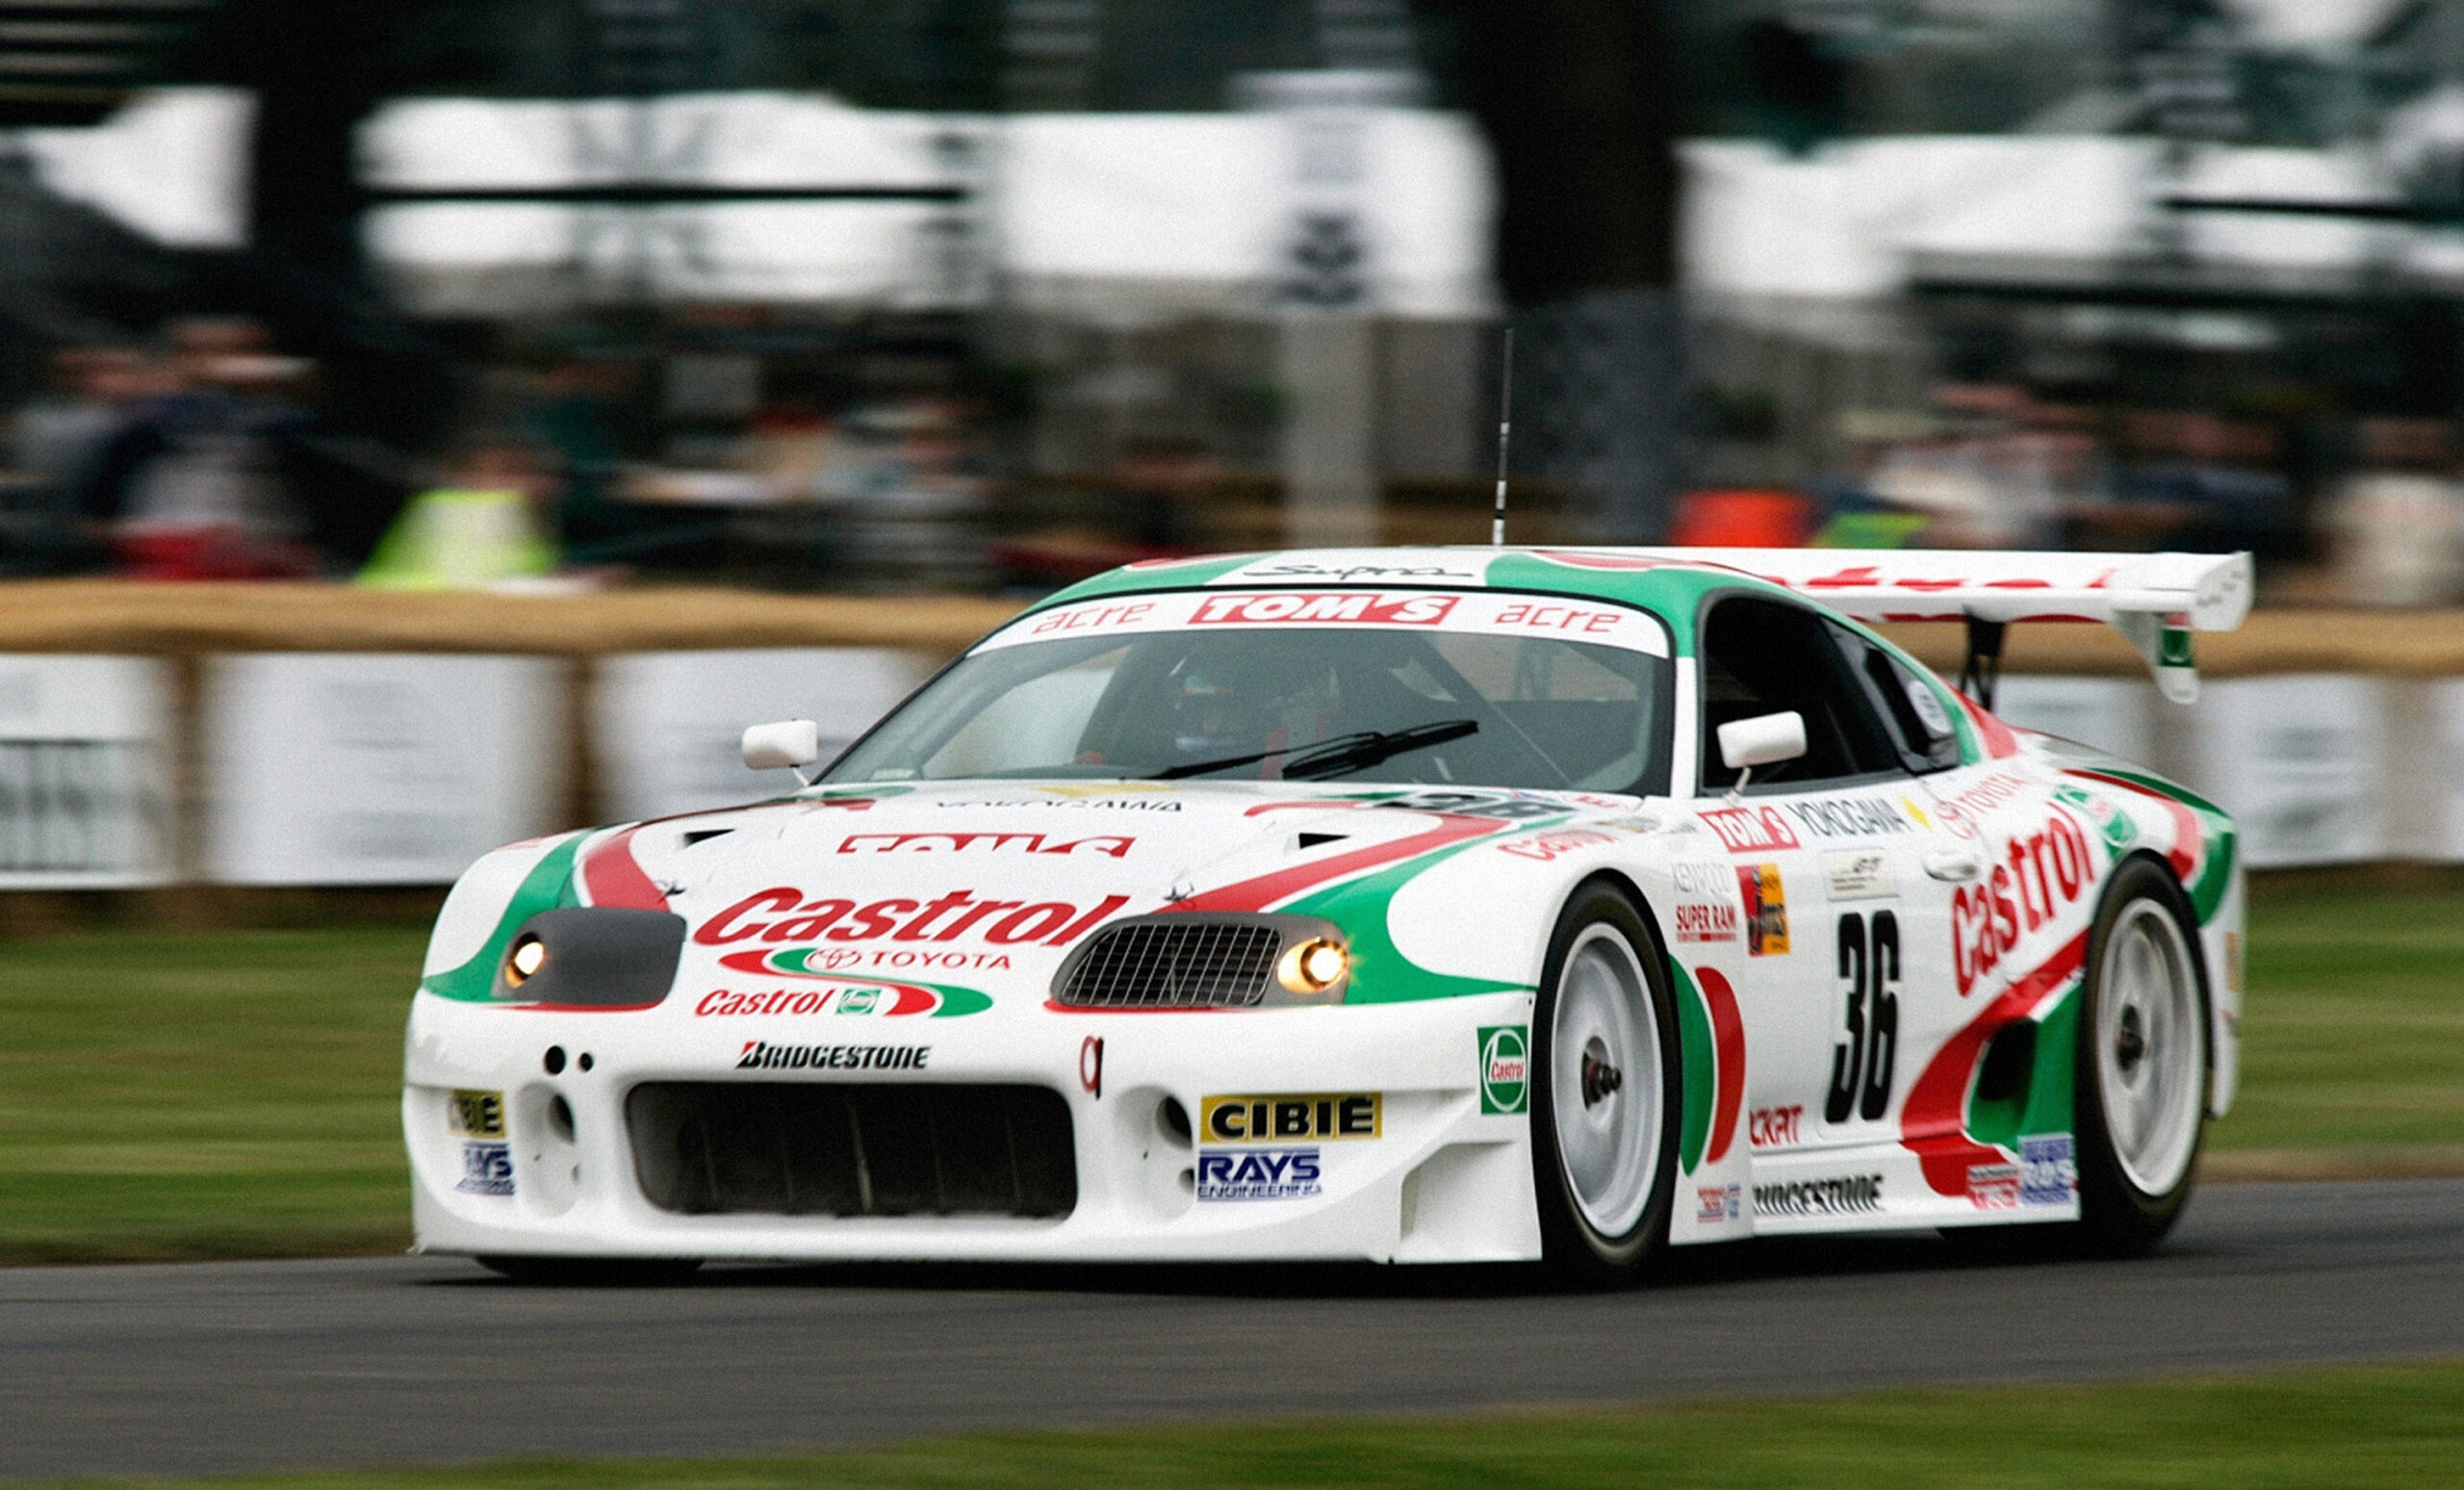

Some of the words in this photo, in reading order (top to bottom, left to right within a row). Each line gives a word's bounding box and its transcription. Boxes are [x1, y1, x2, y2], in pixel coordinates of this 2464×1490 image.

[1244, 564, 1475, 580] Supra
[1032, 604, 1156, 634] acre
[1194, 594, 1448, 624] TOM'S
[1495, 604, 1621, 633] acre
[1786, 798, 1912, 837] YOKOGAWA
[1952, 801, 2096, 999] Castrol
[692, 886, 1131, 947] Castrol
[1676, 904, 1710, 932] SUPER
[872, 951, 1011, 970] TOYOTA
[694, 989, 835, 1017] Castrol
[1825, 910, 1900, 1123] 36
[734, 1040, 933, 1070] BRIDGESTONE
[1197, 1153, 1322, 1184] RAYS
[1197, 1185, 1322, 1199] ENGINEERING
